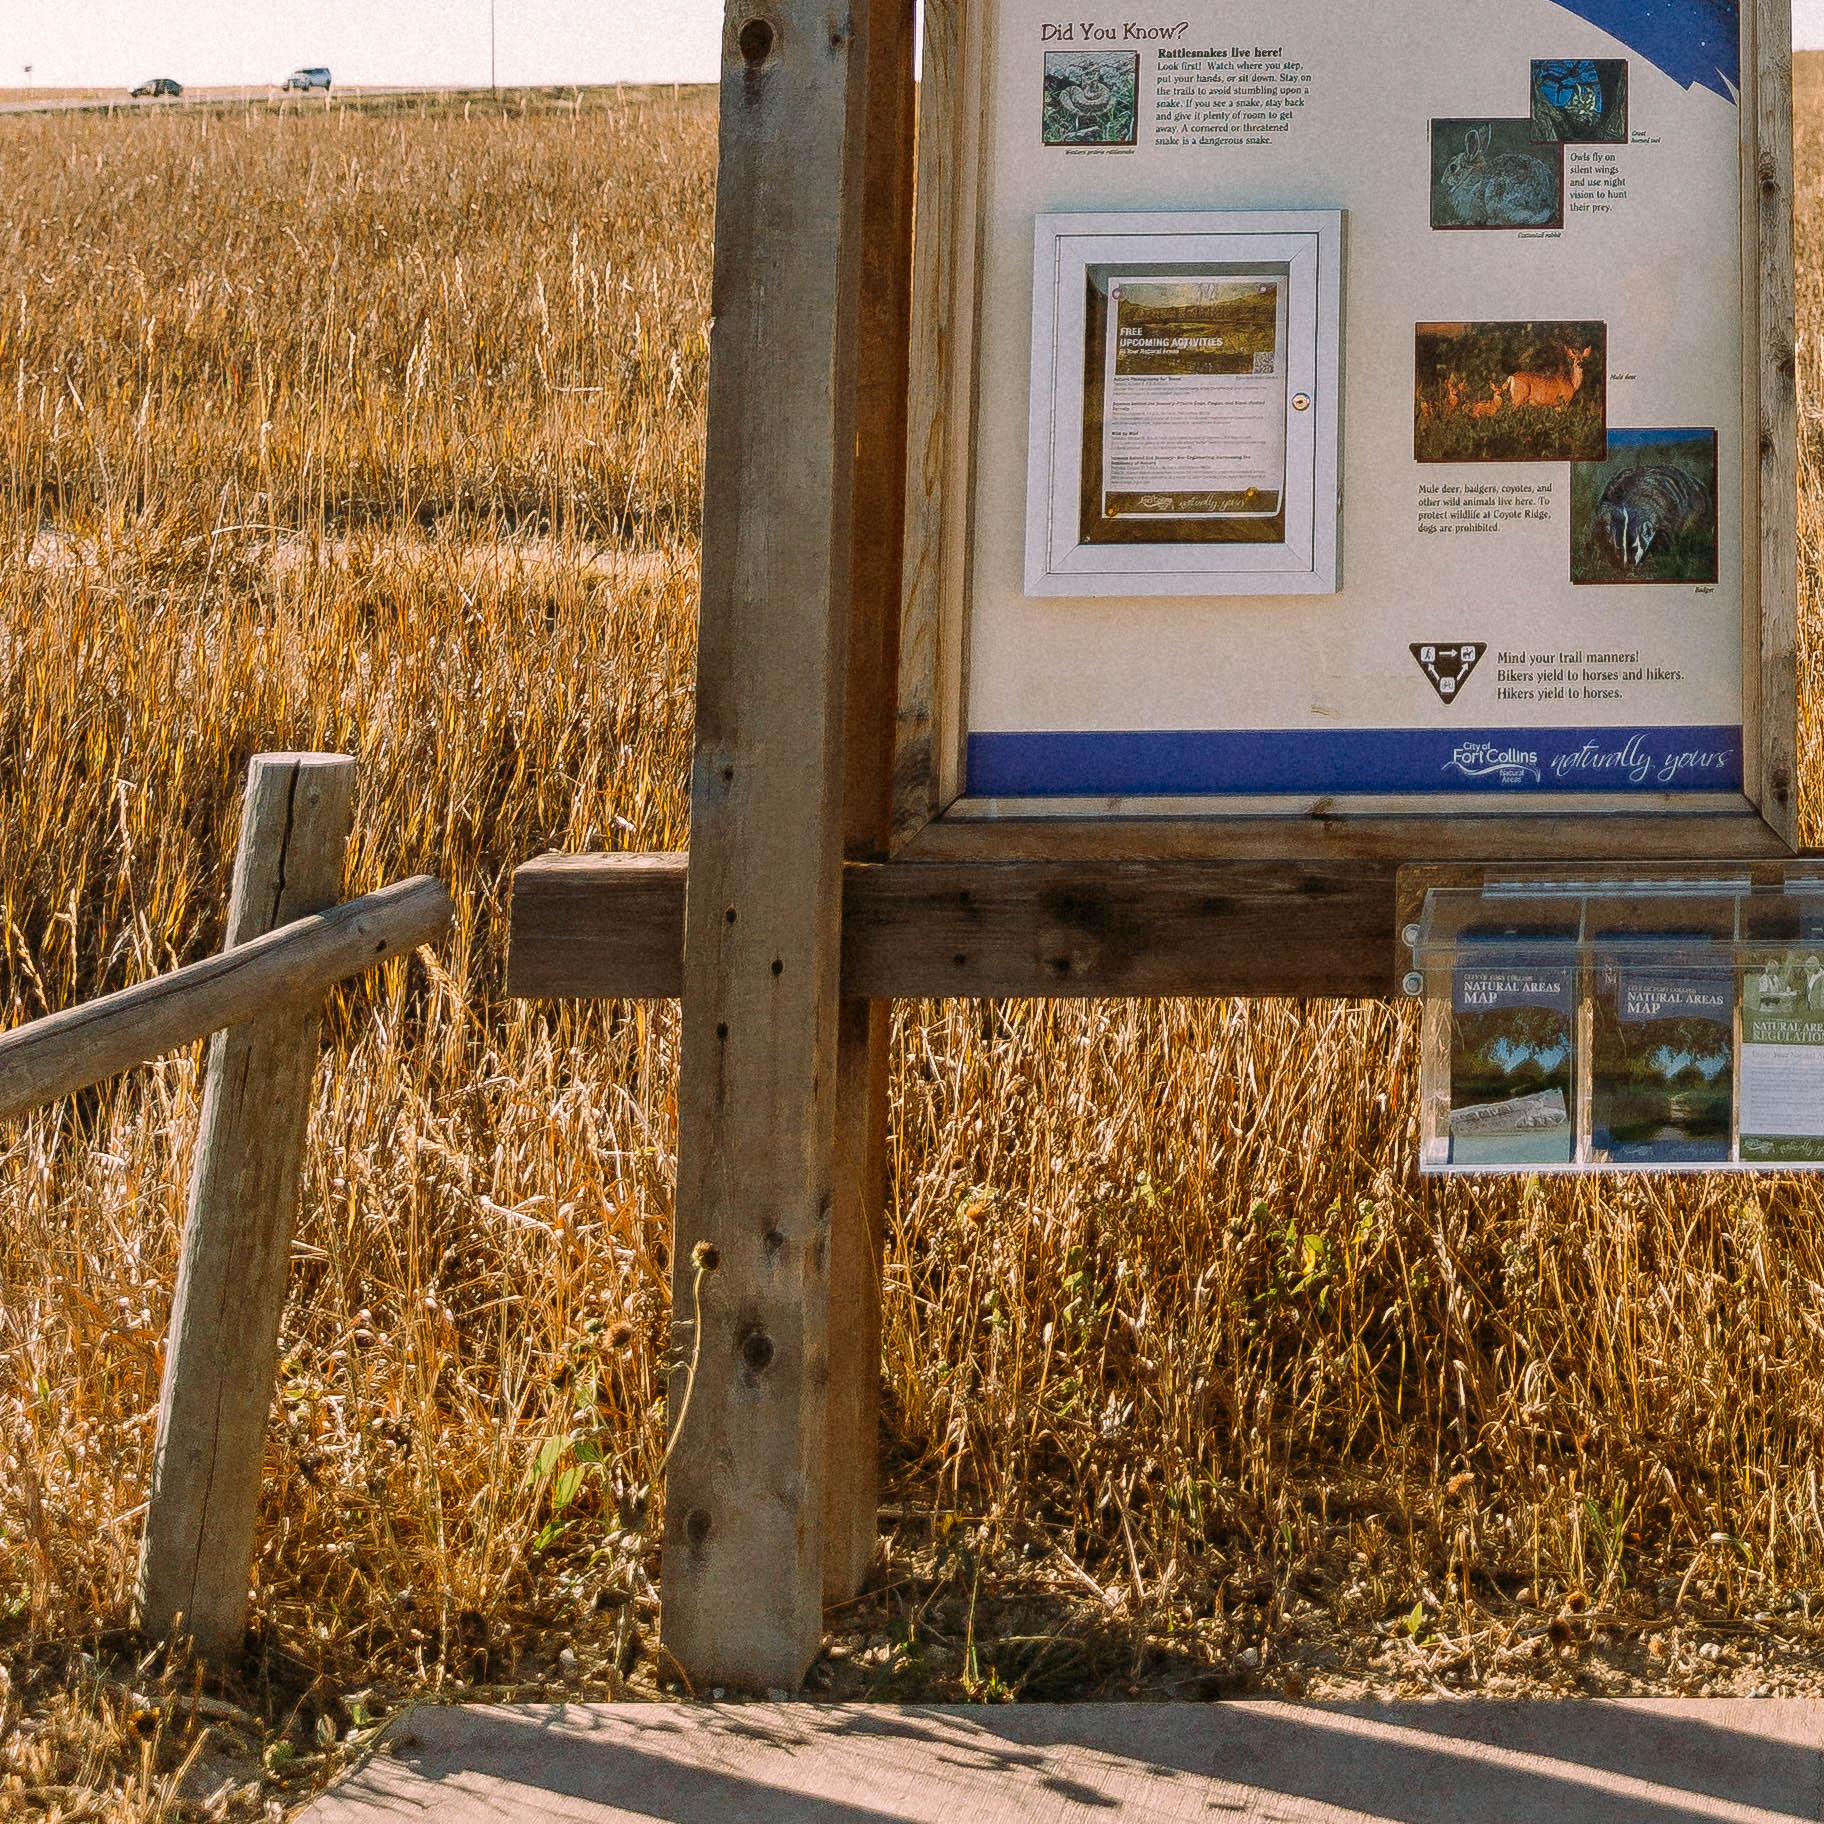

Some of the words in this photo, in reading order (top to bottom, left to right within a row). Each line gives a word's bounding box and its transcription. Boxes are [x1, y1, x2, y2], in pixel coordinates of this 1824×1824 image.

[1040, 22, 1073, 41] Did
[1079, 22, 1116, 40] You
[1122, 21, 1189, 40] Know?
[1157, 47, 1227, 58] Rattlesnakes
[1231, 46, 1250, 57] live
[1254, 46, 1282, 57] here!
[1569, 152, 1591, 162] Owls
[1592, 151, 1603, 163] fly
[1569, 164, 1593, 174] silent
[1594, 164, 1619, 176] wings
[1119, 327, 1144, 337] FREE
[1120, 337, 1170, 348] UPCOMING
[1170, 337, 1224, 349] ACTIVITIES
[1418, 483, 1439, 494] Mule
[1441, 483, 1462, 496] deer,
[1464, 483, 1500, 496] badgers,
[1501, 483, 1534, 496] coyotes,
[1536, 483, 1552, 493] and
[1497, 651, 1525, 663] Mind
[1529, 654, 1555, 666] your
[1559, 650, 1582, 663] trail
[1586, 650, 1638, 663] manners!
[1497, 668, 1533, 681] Bikers
[1536, 668, 1563, 683] yield
[1567, 668, 1578, 681] to
[1582, 668, 1618, 681] horses
[1622, 667, 1642, 680] and
[1646, 667, 1684, 680] hikers.
[1497, 686, 1534, 699] Hikers
[1537, 686, 1564, 701] yield
[1568, 686, 1579, 699] to
[1583, 685, 1622, 698] horses.
[1463, 741, 1482, 752] City
[1481, 741, 1491, 750] of
[1453, 748, 1484, 764] Fort
[1485, 747, 1538, 764] Collins
[1550, 732, 1651, 783] naturally
[1656, 749, 1734, 783] yours
[1463, 981, 1520, 992] NATURAL
[1522, 982, 1561, 993] AREAS
[1463, 991, 1498, 1004] MAP
[1627, 991, 1683, 1004] NATURAL
[1685, 994, 1724, 1006] AREAS
[1626, 1002, 1661, 1014] MAP
[1751, 1021, 1801, 1032] NATURAL
